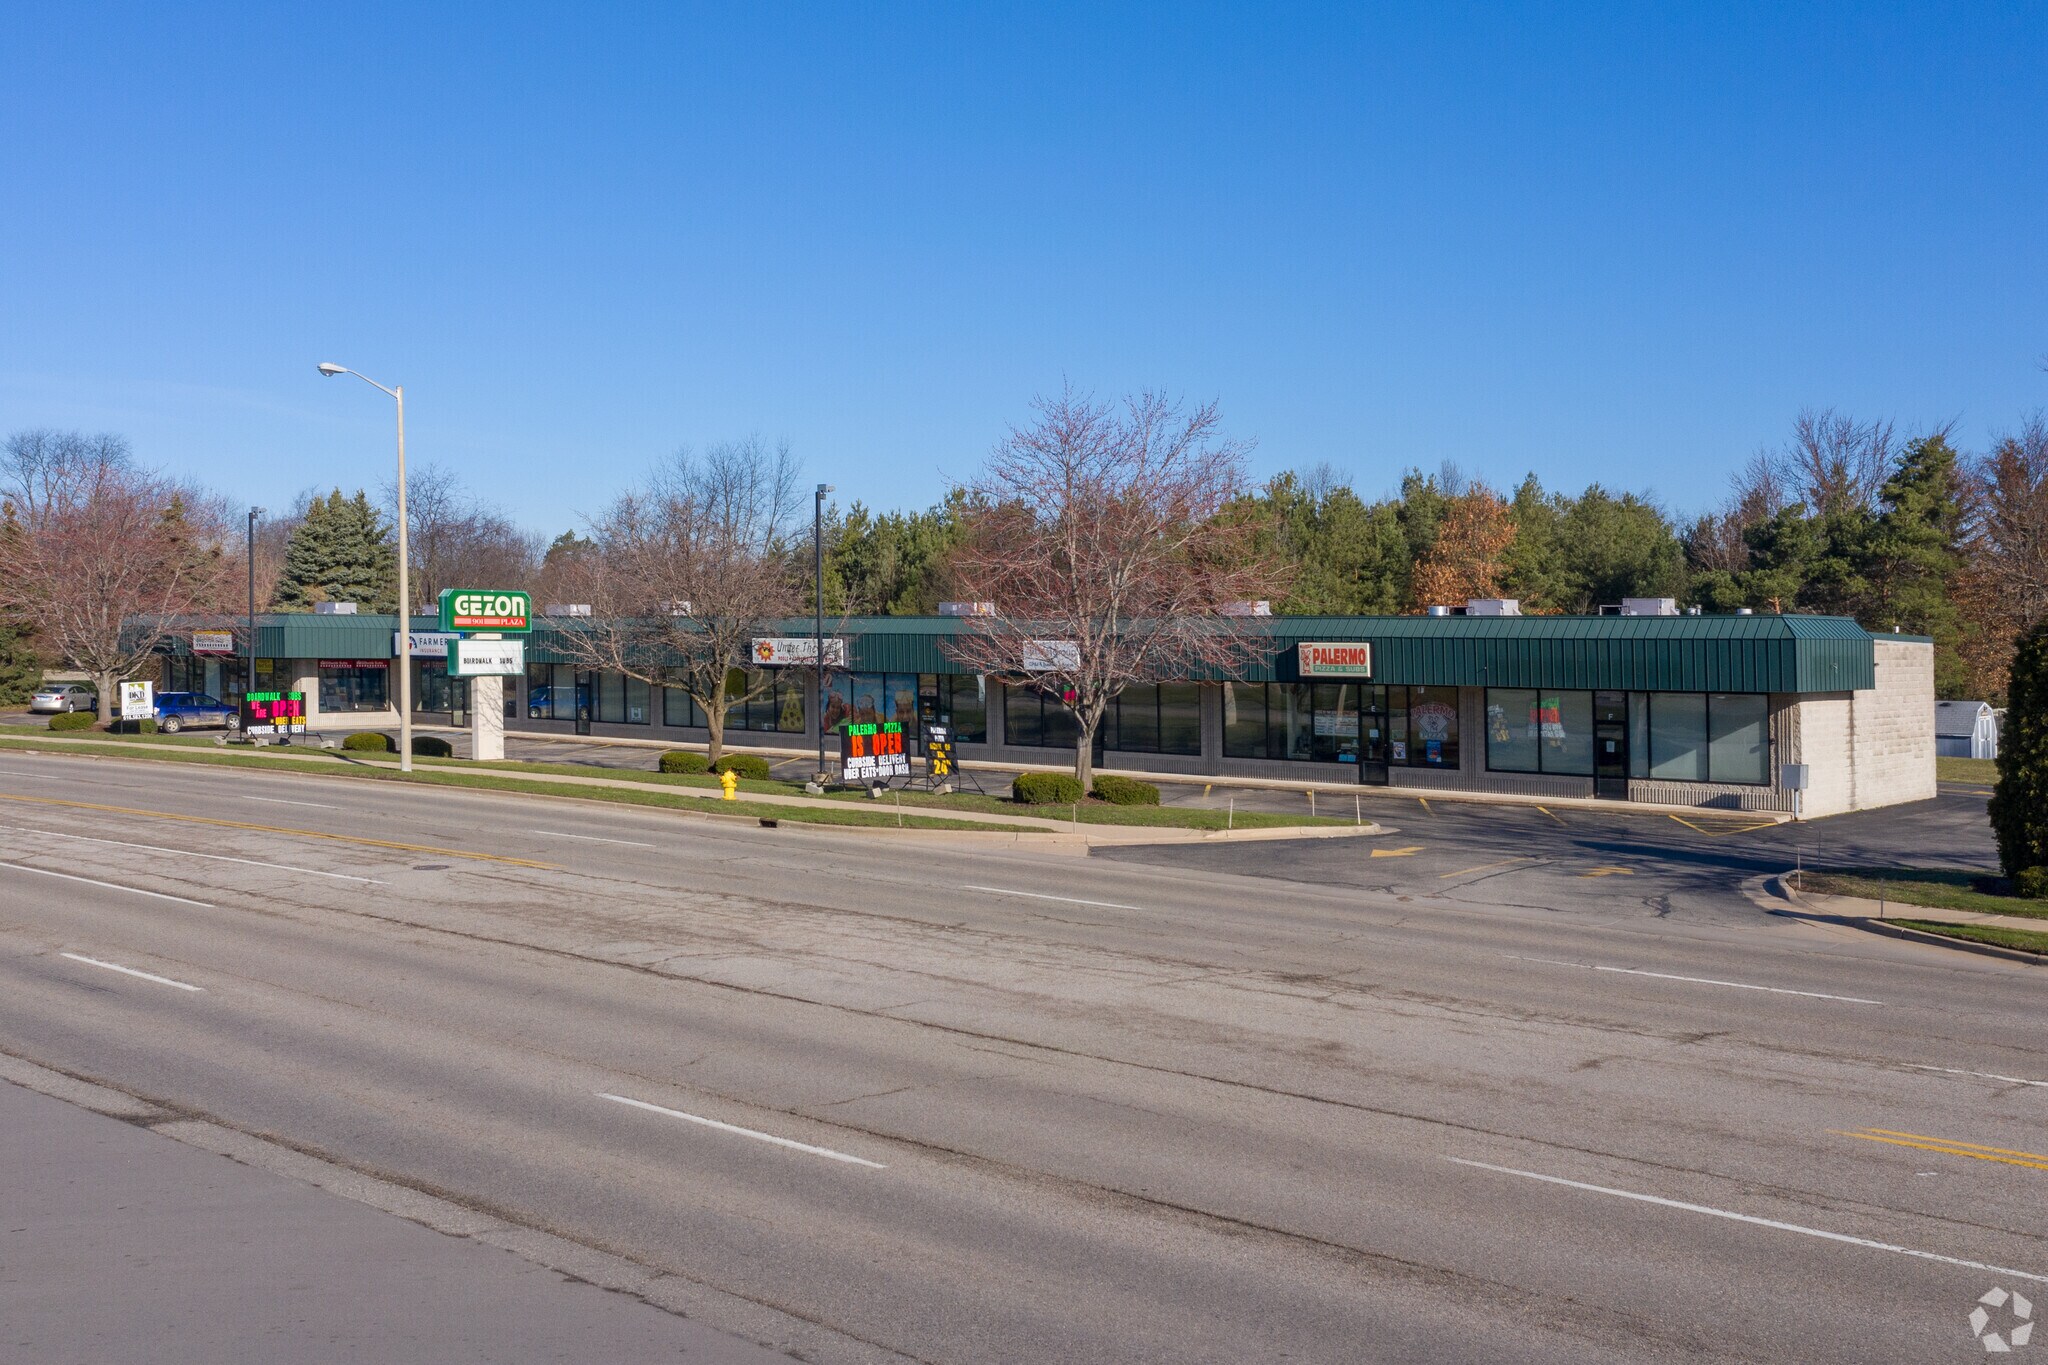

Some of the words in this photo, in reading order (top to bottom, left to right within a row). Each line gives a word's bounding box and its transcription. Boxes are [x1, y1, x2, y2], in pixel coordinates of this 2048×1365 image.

[454, 595, 525, 616] GEZON
[419, 637, 448, 646] FARMER
[1313, 648, 1366, 665] PALERMO
[247, 692, 280, 702] BOARDWALK
[288, 692, 302, 700] SUBS
[251, 701, 260, 710] WE
[256, 708, 267, 718] ARE
[272, 700, 300, 717] OPEN
[275, 717, 289, 725] UBER
[291, 716, 306, 725] EATS
[247, 725, 275, 735] CURBSIDE
[848, 723, 877, 736] PALERMO
[883, 721, 902, 734] PIZZA
[851, 735, 864, 758] IS
[872, 732, 902, 756] OPEN
[847, 756, 875, 769] CURBSIDE
[878, 753, 906, 766] DELIVERY
[843, 768, 860, 780] UBER
[894, 763, 910, 775] DASH
